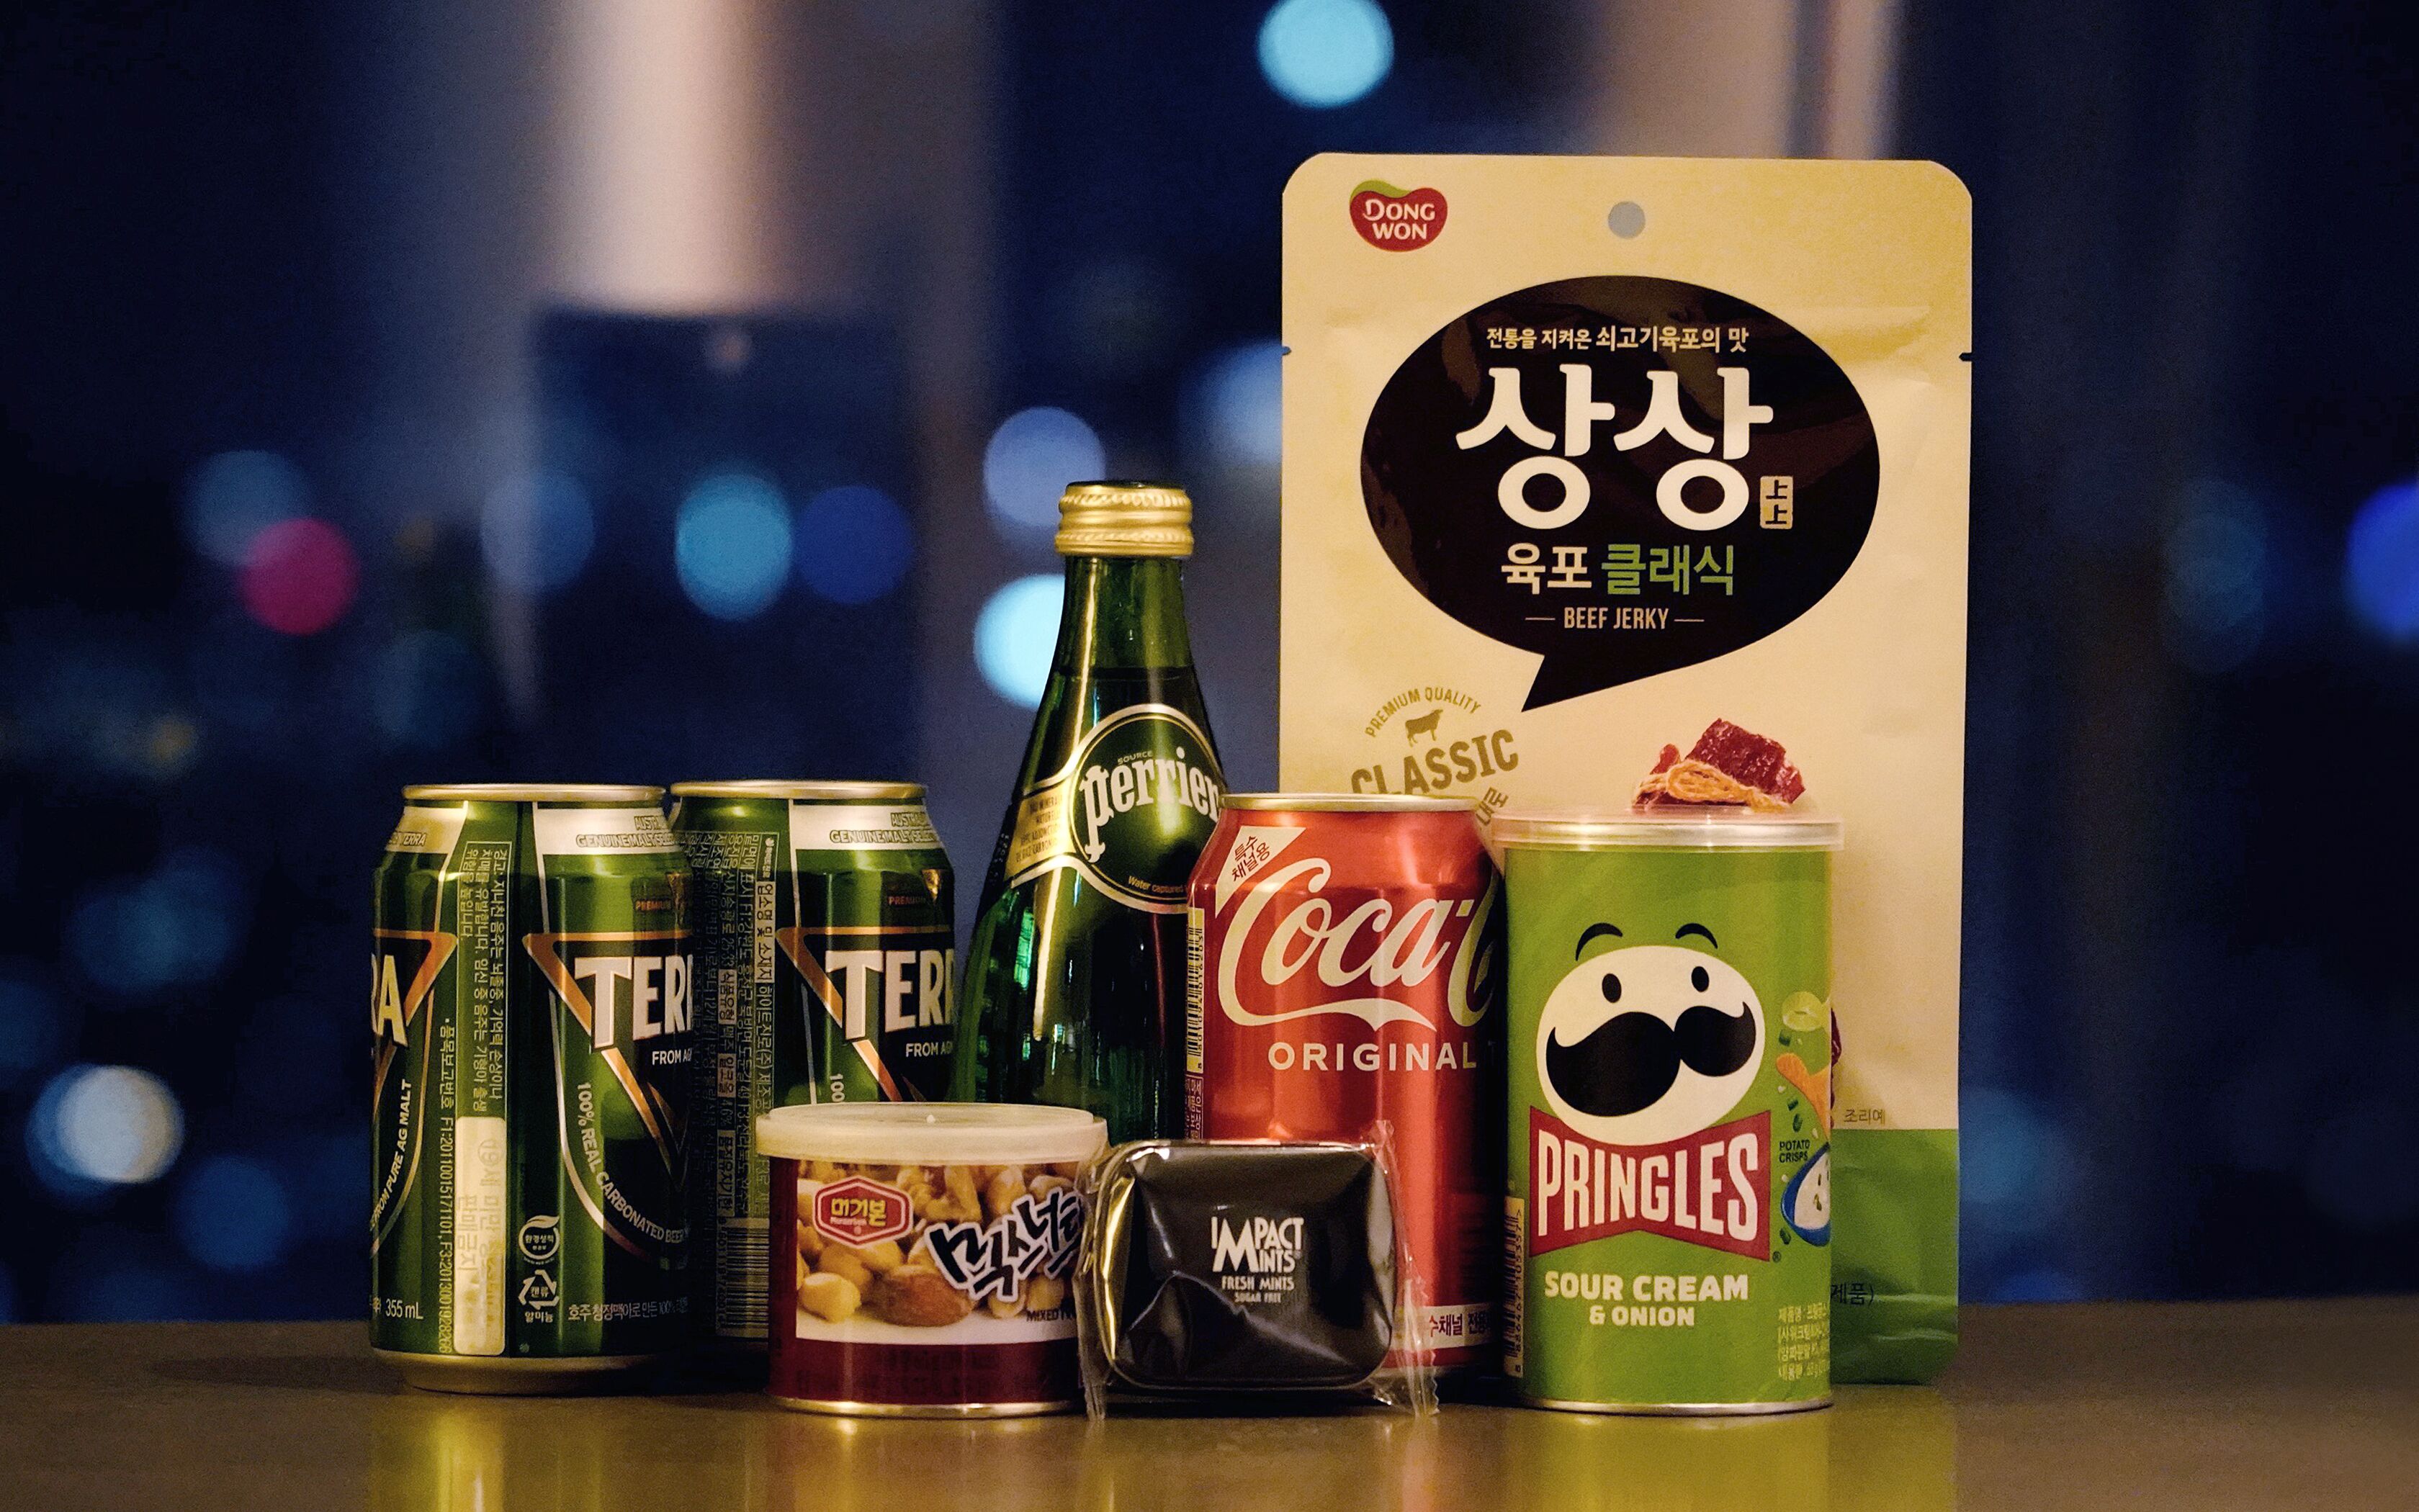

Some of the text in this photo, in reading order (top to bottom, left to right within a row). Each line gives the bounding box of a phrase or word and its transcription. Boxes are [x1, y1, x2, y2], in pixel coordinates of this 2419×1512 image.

[1363, 199, 1436, 222] DONG
[1372, 221, 1427, 242] WON
[1486, 325, 1749, 353] 전통을 지켜온 쇠고기육포의 맛
[1456, 363, 1774, 531] 상상
[1502, 543, 1735, 597] 육포 클래식
[1563, 606, 1669, 631] BEEF JERKY
[1365, 686, 1481, 738] PREMIUM QUALITY
[1117, 750, 1154, 766] SOURCE
[1351, 729, 1519, 795] CLASSIC
[576, 833, 631, 848] GENUINE
[719, 834, 744, 870] 용진읍
[738, 834, 760, 870] 밑면에
[829, 829, 886, 844] GENUINE
[884, 829, 913, 844] MALT
[460, 848, 480, 883] 위험을
[739, 872, 755, 898] 표시
[1128, 875, 1152, 891] Water
[757, 884, 773, 922] 업소명
[757, 926, 773, 938] 및
[488, 848, 508, 1099] 경고: 지나친 음주는 뇌졸중, 기억력 손상이나
[757, 942, 774, 981] 소재지
[472, 849, 493, 1112] 치매를 유발합니다. 임신 중 음주는 기형아 출생
[737, 964, 753, 1001] 홍천군
[719, 972, 735, 1021] 식품유형
[722, 1026, 735, 1051] 맥주
[737, 1004, 753, 1042] 북방면
[755, 986, 773, 1069] 하이트진로(주)
[652, 1049, 682, 1066] FROM
[737, 1045, 752, 1083] 도둔길
[905, 1041, 939, 1058] FROM
[1267, 1041, 1477, 1072] ORIGINAL
[719, 1056, 735, 1094] 알코올
[398, 1078, 413, 1126] MALT
[578, 1081, 596, 1128] 100%
[1842, 1107, 1886, 1126] 조리예
[396, 1128, 409, 1152] AG
[580, 1127, 603, 1174] REAL
[1779, 1139, 1810, 1151] POTATO
[385, 1151, 404, 1193] PURE
[1779, 1151, 1808, 1164] CRISPS
[1538, 1128, 1759, 1242] PRINGLES
[596, 1171, 665, 1242] CARBONATED
[830, 1197, 887, 1228] 머거본
[457, 1194, 479, 1271] 판매금지
[530, 1286, 549, 1299] 캔류
[1220, 1275, 1296, 1292] FRESH MINTS
[1544, 1270, 1749, 1302] SOUR CREAM
[385, 1297, 403, 1319] 355
[404, 1300, 425, 1320] mL
[524, 1310, 554, 1323] 알미늄
[567, 1303, 592, 1323] 호주
[642, 1301, 658, 1318] 만든
[1026, 1308, 1059, 1323] MIXED
[1589, 1305, 1695, 1327] & ONION
